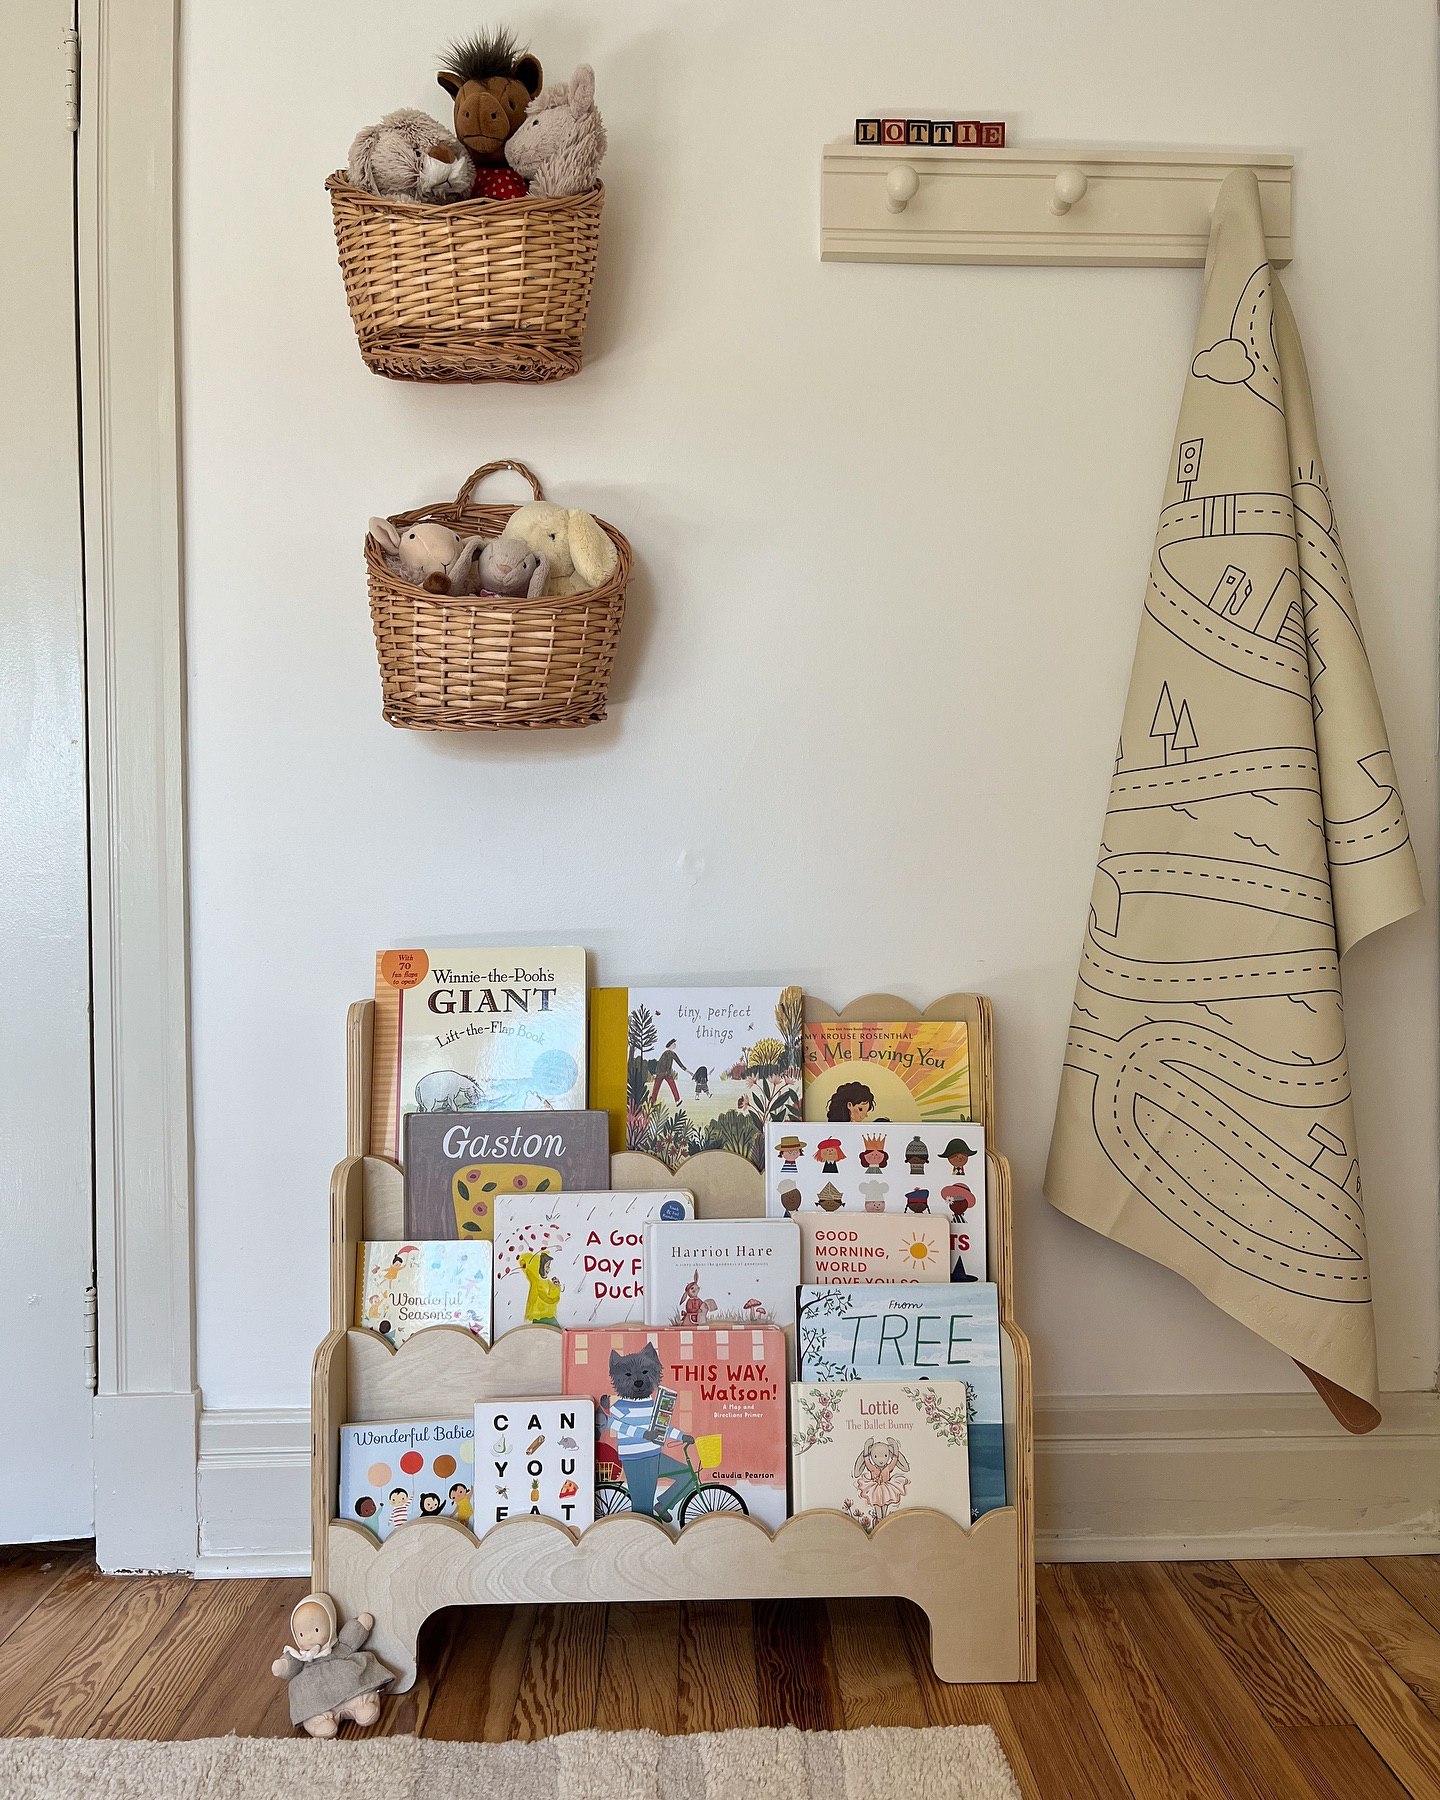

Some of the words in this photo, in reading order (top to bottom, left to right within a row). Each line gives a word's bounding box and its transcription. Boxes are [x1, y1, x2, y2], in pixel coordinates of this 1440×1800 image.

[861, 123, 1000, 145] LOTTIE
[398, 962, 412, 971] 70
[431, 966, 556, 985] Winnie-the-Pooh's
[427, 987, 558, 1015] GIANT
[678, 1004, 702, 1023] tiny,
[707, 1003, 752, 1021] perfect
[434, 1020, 515, 1049] Lift-the-Flap
[516, 1023, 546, 1046] Book
[695, 1025, 734, 1044] things
[820, 1032, 857, 1040] KROUSE
[859, 1032, 914, 1040] ROSENTHAL
[823, 1041, 852, 1061] Me
[858, 1041, 915, 1068] Loving
[916, 1047, 946, 1070] You
[442, 1125, 567, 1159] Gaston
[586, 1230, 602, 1247] A
[609, 1229, 643, 1247] Go
[815, 1230, 859, 1242] GOOD
[671, 1245, 730, 1258] Harriot
[736, 1244, 773, 1257] Hare
[815, 1245, 890, 1260] MORNING,
[583, 1255, 625, 1278] Day
[815, 1260, 868, 1273] WORLD
[388, 1291, 464, 1310] Wonderful
[888, 1300, 924, 1310] From
[398, 1306, 453, 1321] Seasons
[841, 1314, 974, 1367] TREE
[670, 1364, 718, 1382] THIS
[726, 1364, 769, 1383] WAY,
[700, 1383, 777, 1401] Watson!
[728, 1403, 741, 1411] Map
[859, 1398, 899, 1416] Lottie
[493, 1412, 575, 1431] CAN
[845, 1419, 862, 1430] The
[863, 1418, 887, 1430] Ballet
[888, 1418, 914, 1432] Bunny
[353, 1426, 431, 1448] Wonderful
[433, 1424, 475, 1441] Babie
[494, 1458, 575, 1478] YOU
[711, 1471, 742, 1479] Claudia
[744, 1471, 775, 1479] Pearson
